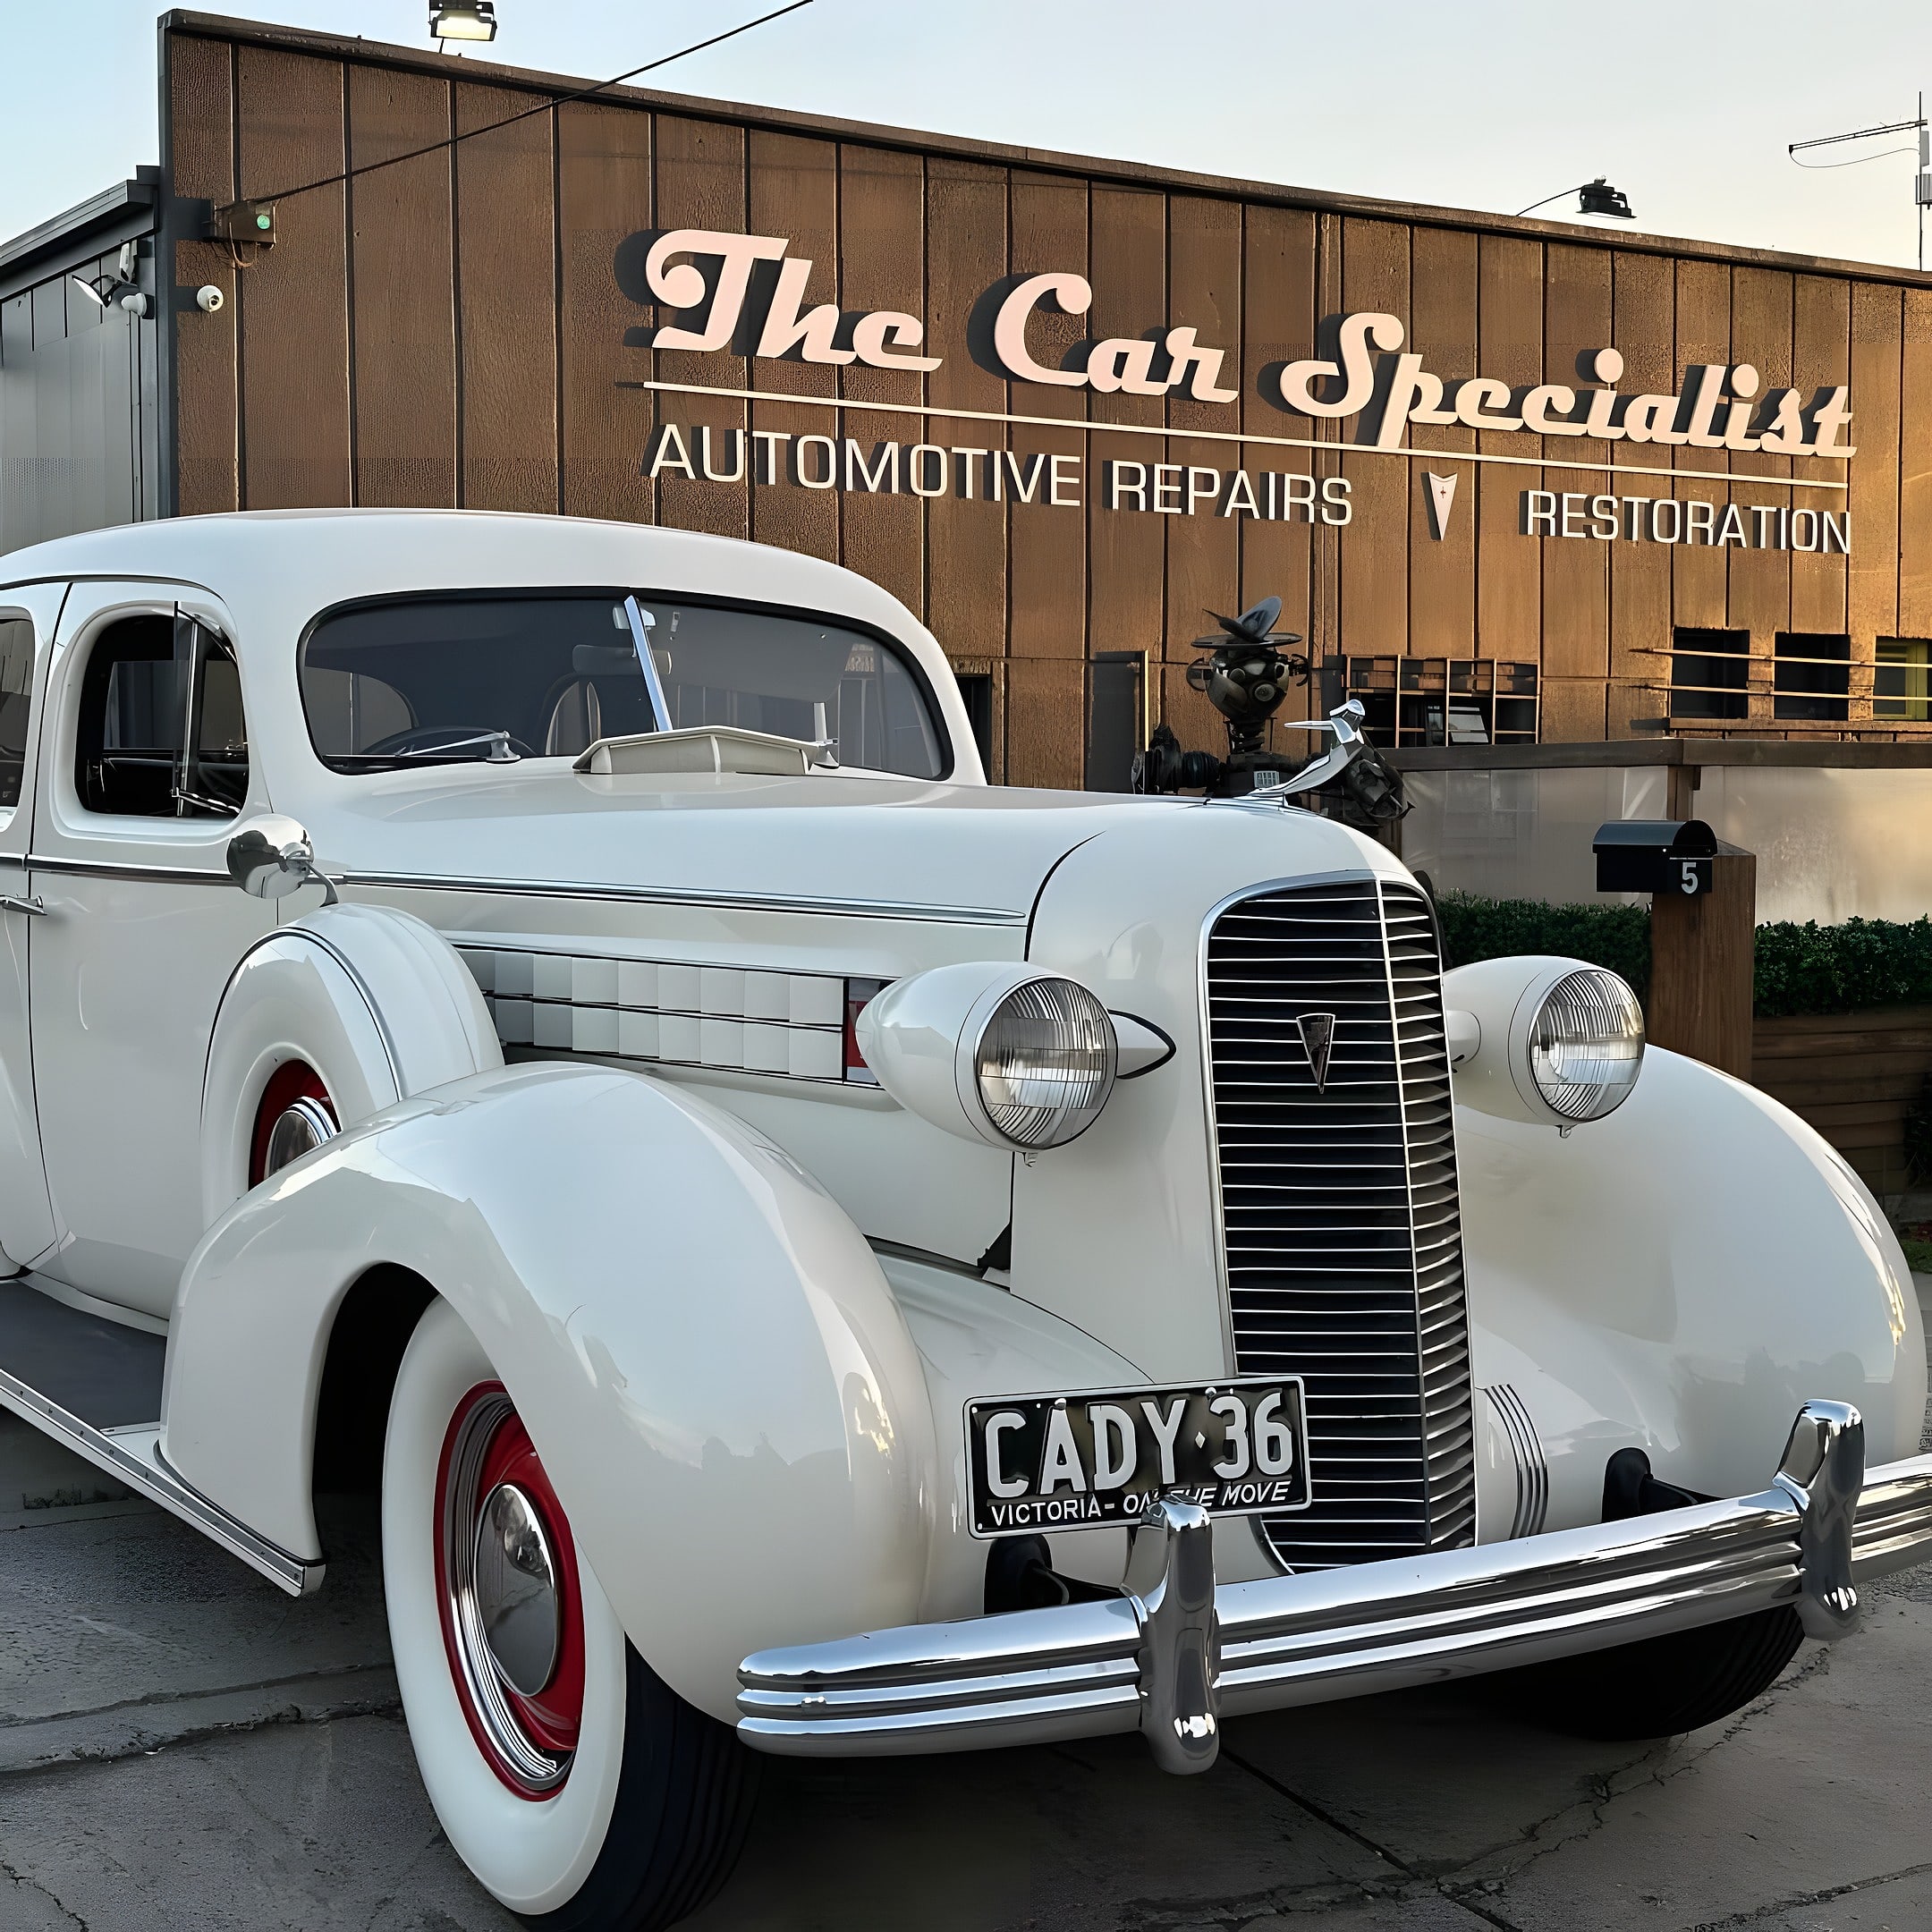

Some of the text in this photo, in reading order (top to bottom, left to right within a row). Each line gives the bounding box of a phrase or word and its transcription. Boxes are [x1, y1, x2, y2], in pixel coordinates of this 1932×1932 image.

[646, 229, 1858, 458] The Car Specialist
[649, 423, 1851, 555] AUTOMOTIVE REPAIRS RESTORATION
[1682, 862, 1698, 894] 5
[985, 1393, 1292, 1498] CADY 36
[1221, 1481, 1292, 1506] MOVE
